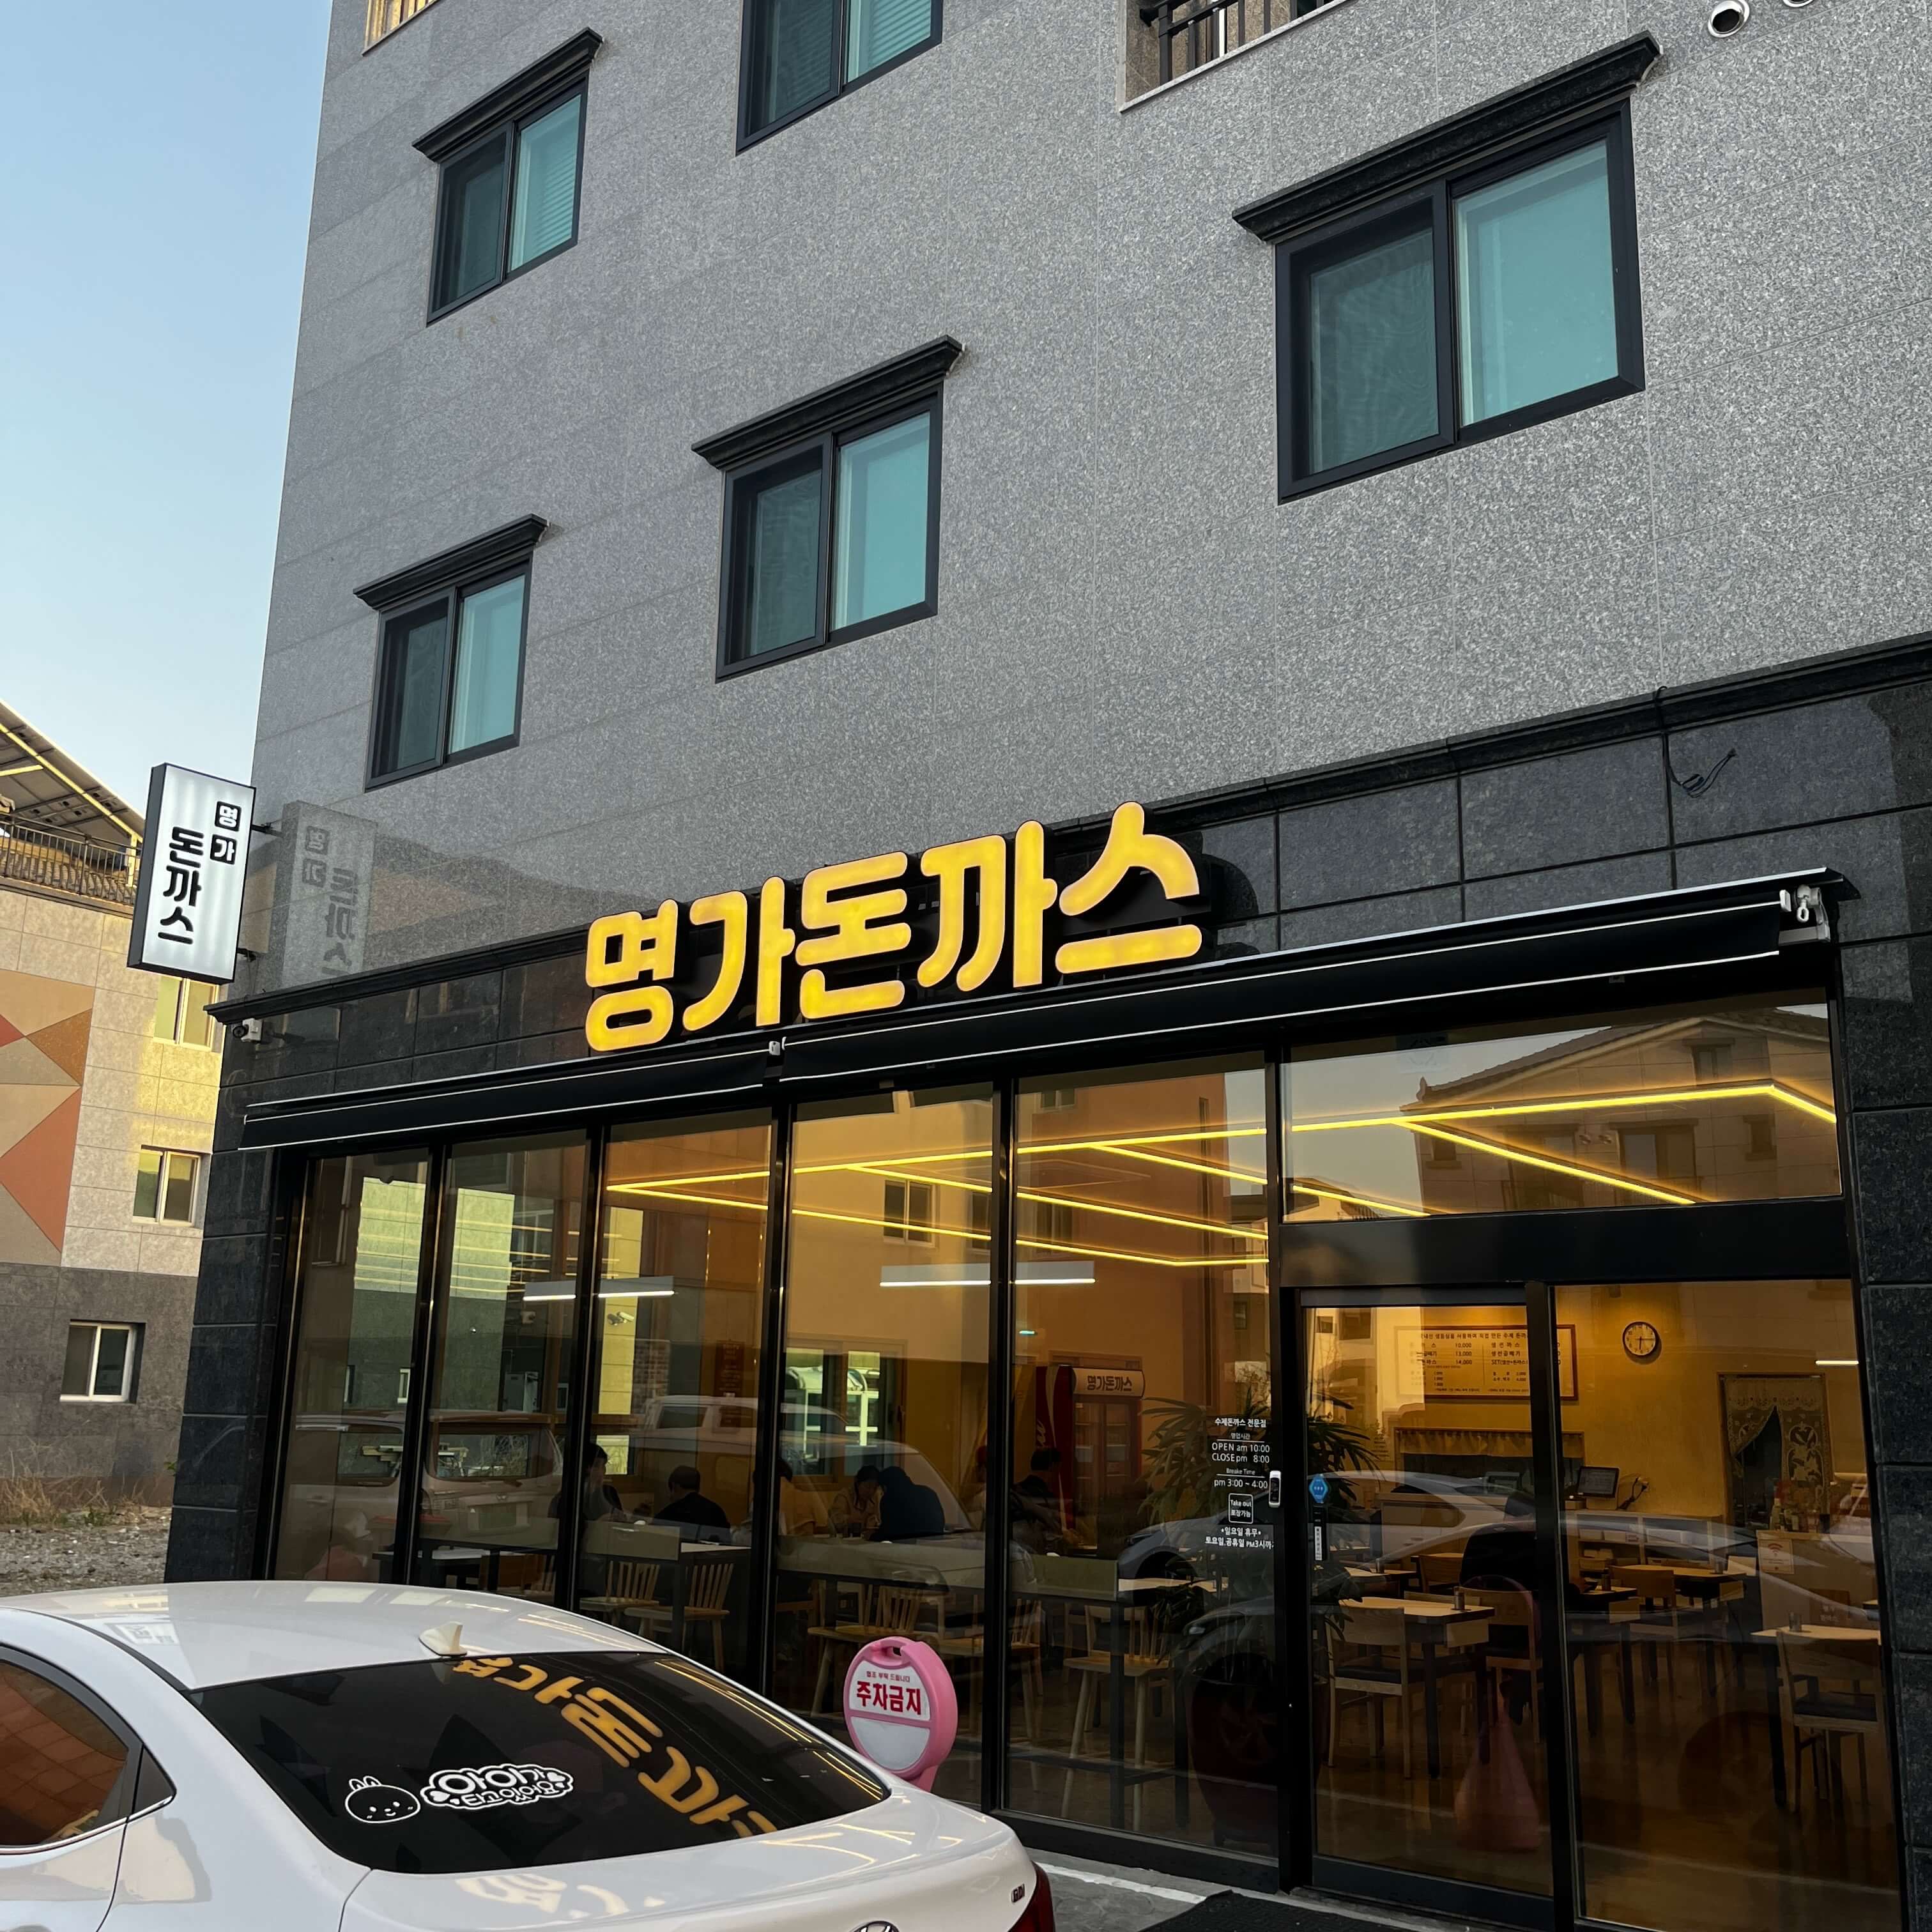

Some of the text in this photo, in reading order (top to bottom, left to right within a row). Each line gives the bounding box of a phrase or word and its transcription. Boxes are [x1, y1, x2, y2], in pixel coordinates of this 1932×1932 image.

[213, 803, 240, 862] 명가
[158, 826, 204, 945] 돈까스
[585, 801, 1202, 1052] 명가돈까스
[1087, 1375, 1133, 1392] 명가돈까스
[1215, 1417, 1267, 1428] 수제돈까스 전문점
[1211, 1442, 1234, 1452] OPEN
[1250, 1444, 1270, 1453] 10:00
[1211, 1452, 1235, 1462] CLOSE
[1253, 1455, 1270, 1463] 8:00
[1214, 1479, 1226, 1487] pm
[1227, 1478, 1243, 1487] 3:00
[1251, 1480, 1268, 1489] 4:00
[1230, 1509, 1251, 1519] 포장가능
[866, 1670, 910, 1683] 협조 부탁 드립니다
[856, 1680, 921, 1715] 주차금지
[438, 1767, 546, 1795] 아이가
